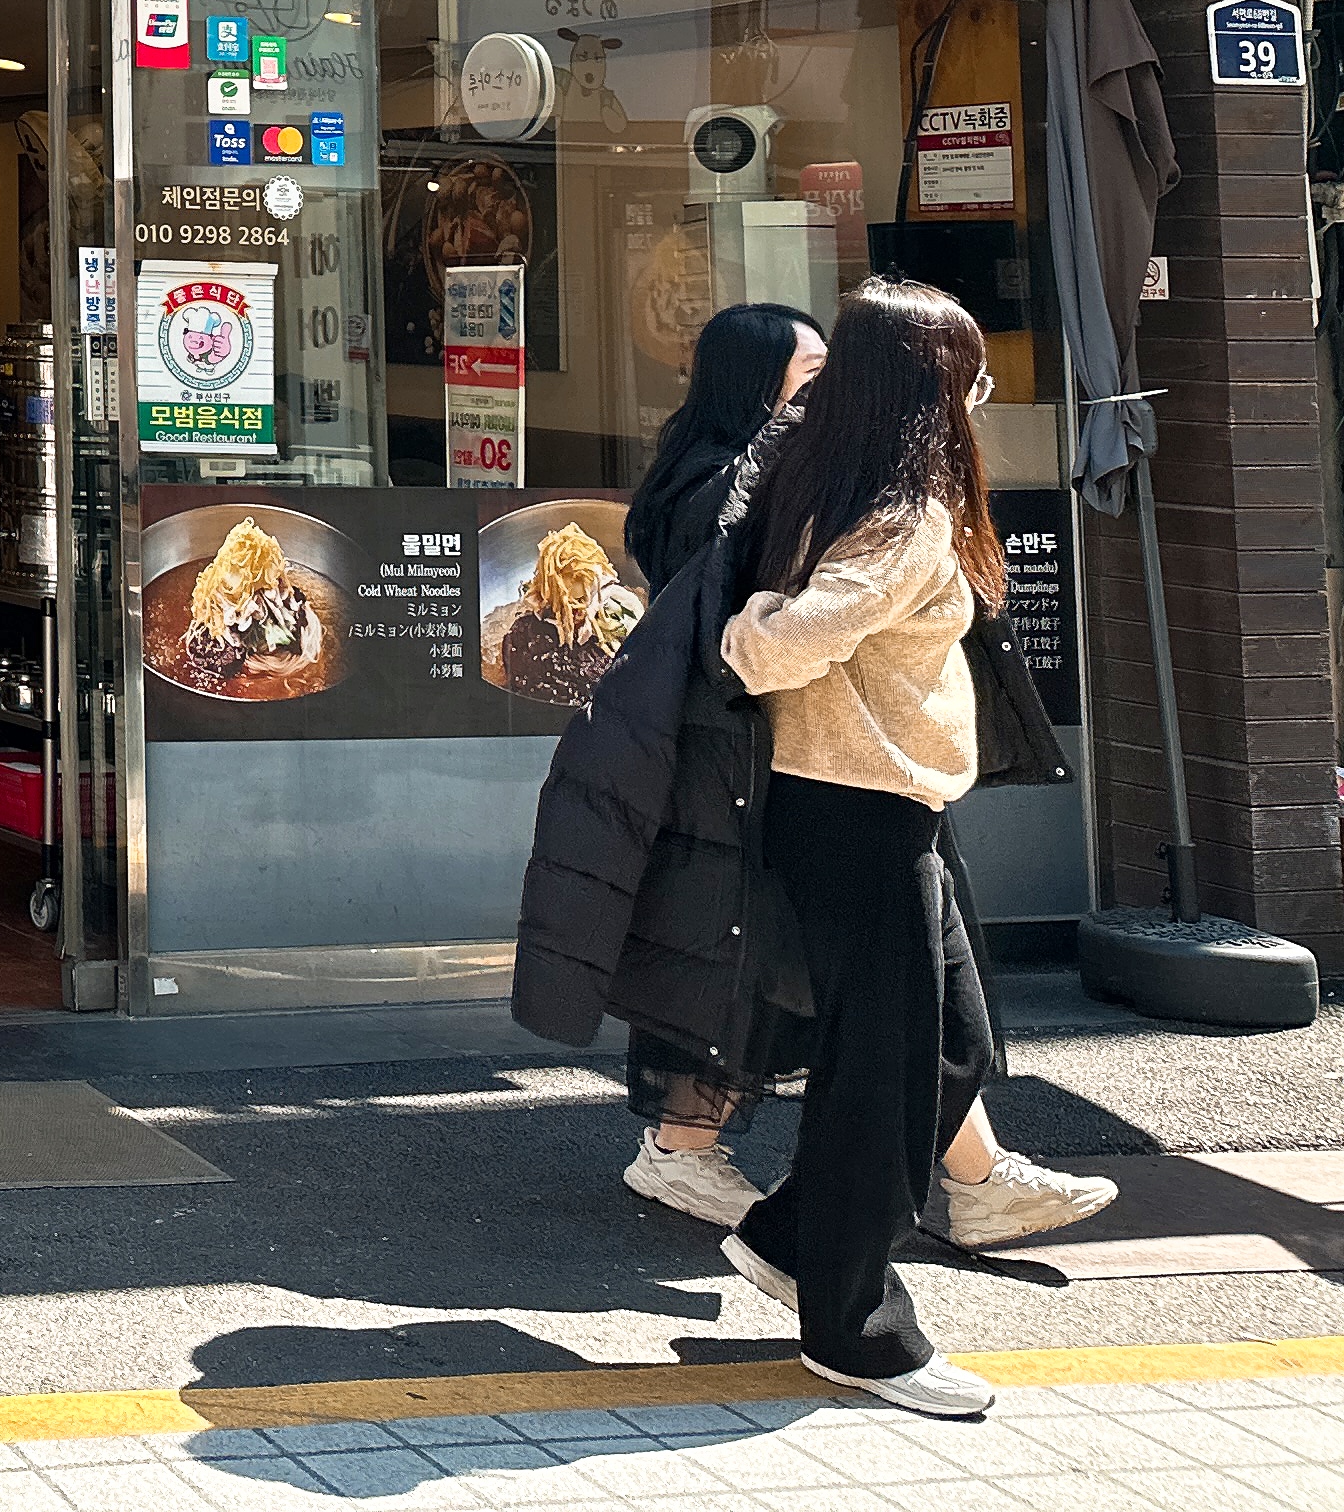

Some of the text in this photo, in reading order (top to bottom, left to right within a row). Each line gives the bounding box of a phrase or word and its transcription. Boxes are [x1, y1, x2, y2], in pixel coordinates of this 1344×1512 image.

[1238, 40, 1276, 73] 39
[920, 107, 1009, 132] CCTV녹화중
[161, 186, 261, 212] 체인점문의
[135, 224, 290, 246] 010 9298 2864
[1142, 288, 1166, 298] 연구역
[149, 406, 262, 430] 모범음식점
[155, 431, 257, 444] Good Restaurant
[401, 533, 461, 556] 물밀면
[1005, 533, 1058, 554] 손만두
[379, 562, 461, 578] (Mul Milmyeon)
[357, 584, 461, 597] Cold Wheat Noodles
[1011, 580, 1060, 594] Dumplings
